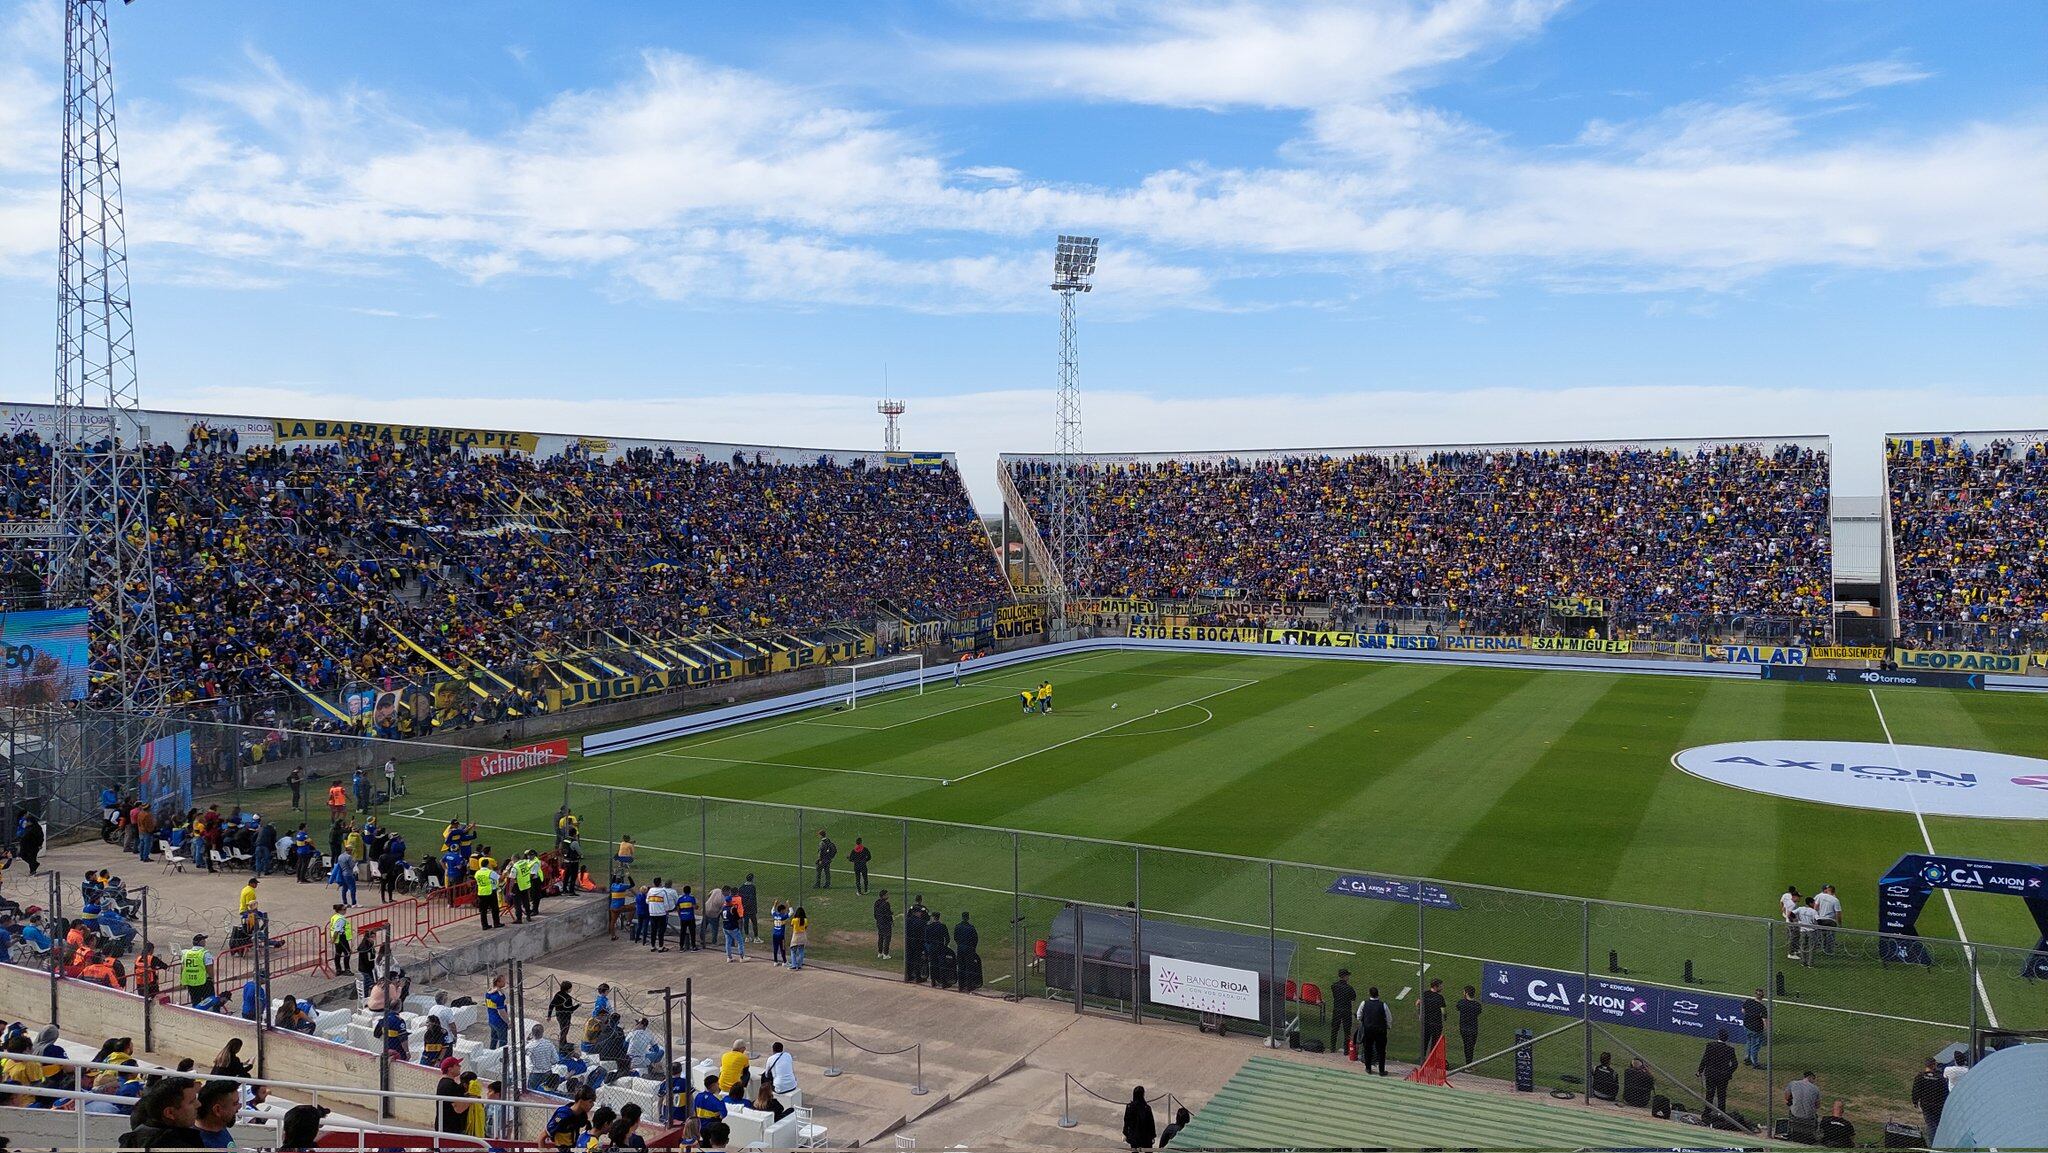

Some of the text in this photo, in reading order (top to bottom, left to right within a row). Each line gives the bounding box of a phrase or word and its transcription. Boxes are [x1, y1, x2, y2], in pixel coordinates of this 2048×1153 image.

[276, 422, 308, 438] LA
[997, 603, 1037, 621] BOULOGNE
[1101, 600, 1157, 613] MATHEU
[1220, 602, 1305, 617] ANDERSON
[1129, 624, 1257, 643] ESTO ES BOCA!!!
[1358, 634, 1438, 650] SAN JUSTO
[1446, 636, 1528, 650] PATERNAL
[1538, 638, 1622, 652] SAN MIGUEL
[786, 648, 814, 668] 12
[1722, 646, 1803, 665] TALAR
[1813, 648, 1882, 659] CONTIGO SIEMPRE
[1901, 651, 2020, 672] LEOPARDI
[480, 746, 553, 777] Schneider
[1712, 756, 1978, 784] AXION
[1853, 774, 1977, 788] energy
[1951, 869, 1984, 885] CA
[1989, 877, 2025, 887] AXION
[1351, 881, 1366, 891] CA
[186, 959, 198, 967] RL
[1186, 975, 1249, 993] BANCO RiOJA
[1527, 979, 1570, 1005] CA
[1610, 984, 1635, 992] EDICIÓN
[1542, 1003, 1570, 1011] ARGENTINA
[1578, 993, 1625, 1010] AXION
[1602, 1007, 1624, 1017] energy
